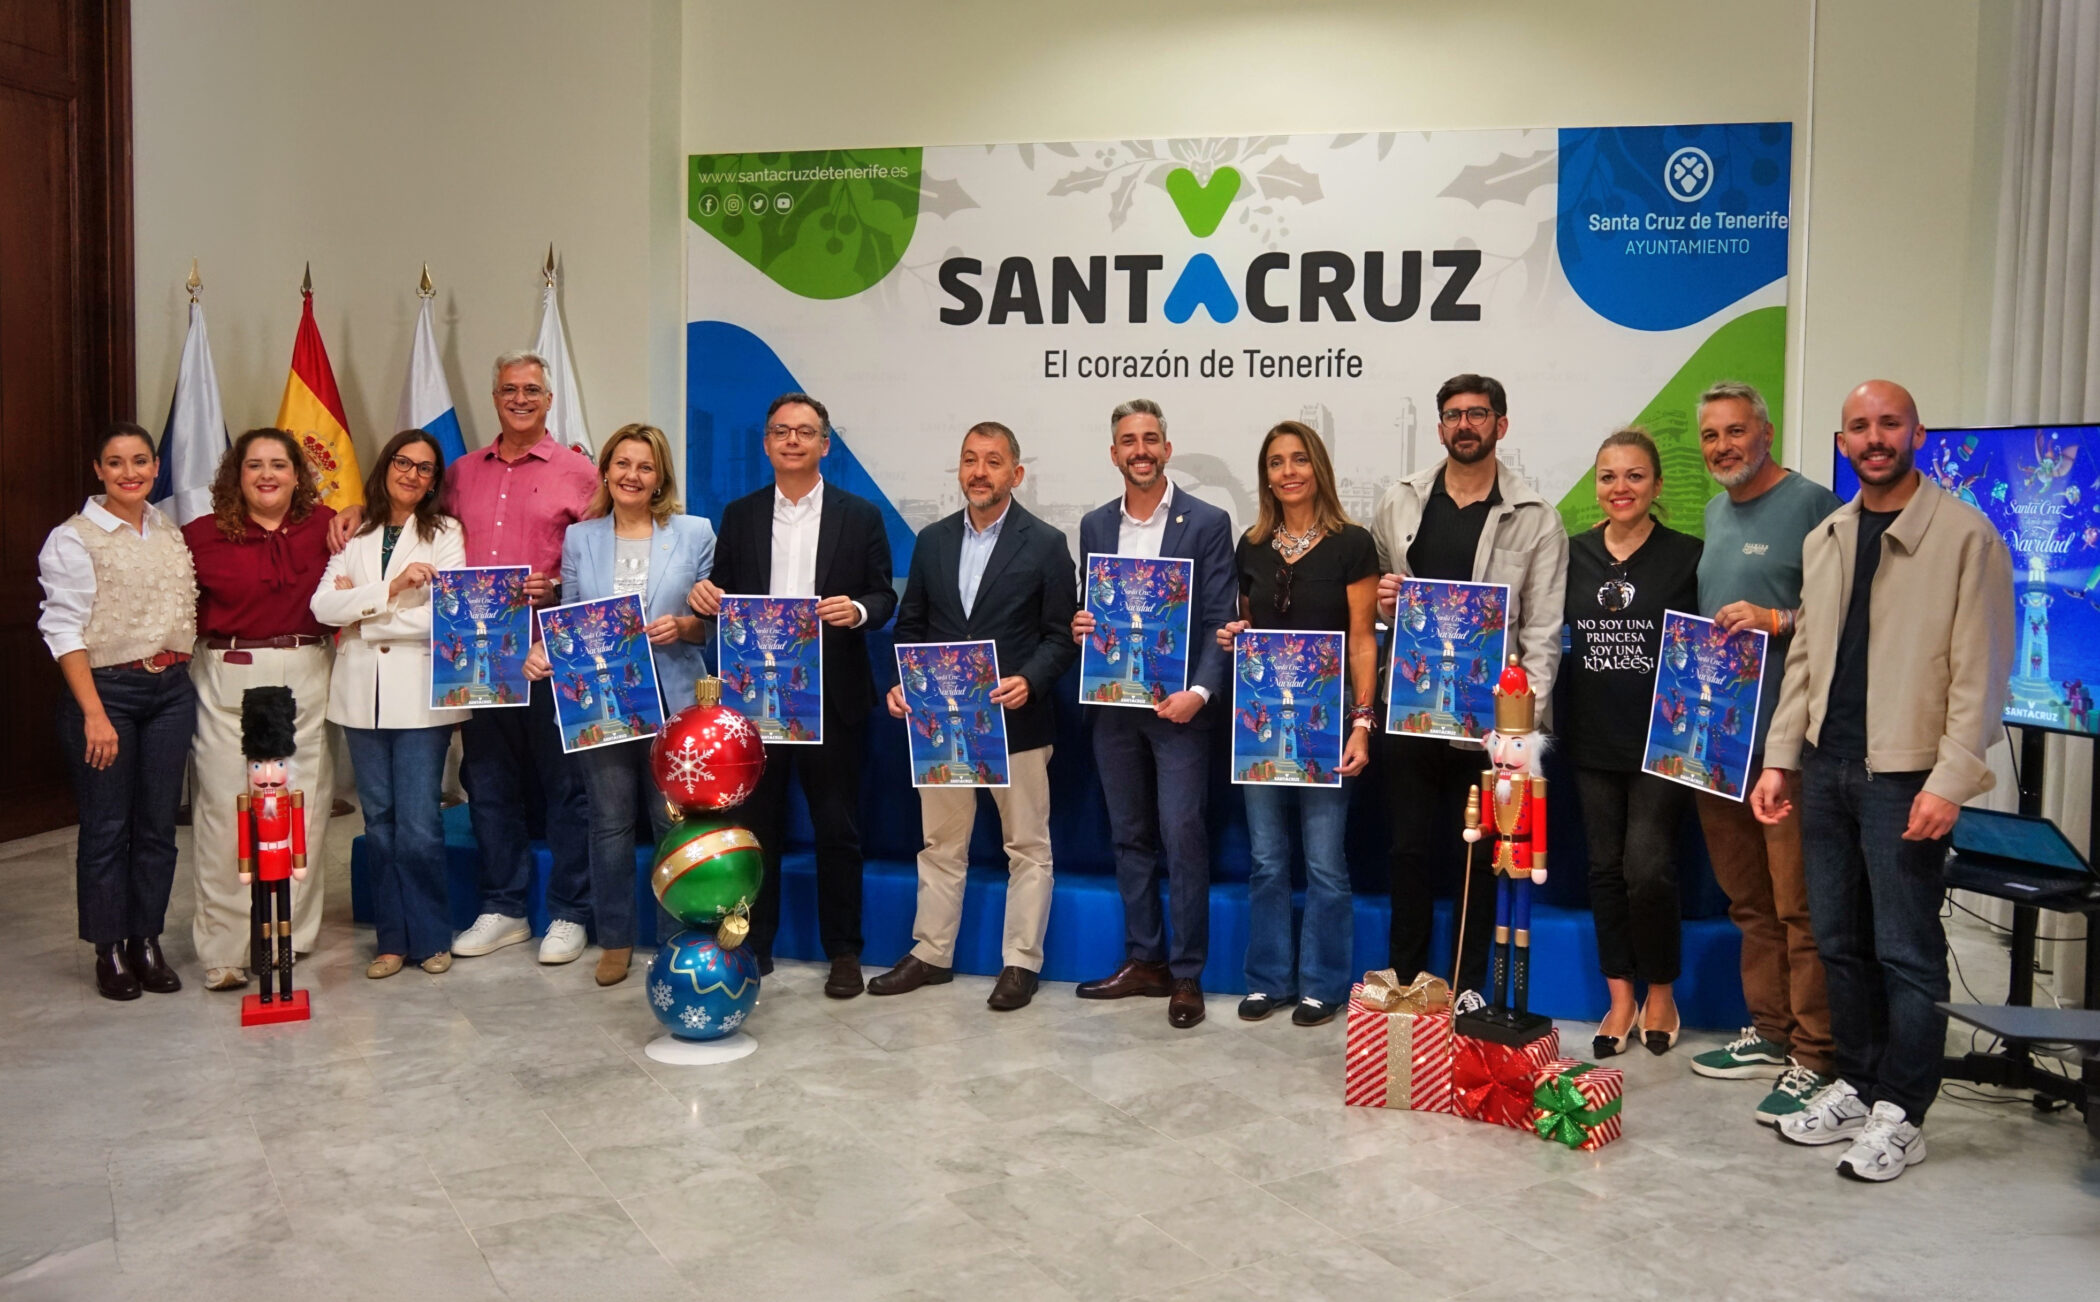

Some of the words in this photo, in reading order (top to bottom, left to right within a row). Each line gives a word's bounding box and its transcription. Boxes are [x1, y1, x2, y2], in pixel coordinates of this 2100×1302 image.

[699, 164, 908, 184] www.santacruzdetenerife.es
[1588, 213, 1640, 232] Santa
[1644, 212, 1686, 231] Cruz
[1690, 211, 1711, 230] de
[1715, 210, 1789, 231] Tenerife
[1625, 238, 1750, 256] AYUNTAMIENTO
[1044, 350, 1068, 378] El
[1076, 347, 1190, 379] corazón
[1199, 349, 1234, 378] de
[1242, 347, 1364, 379] Tenerife
[2004, 500, 2038, 516] Santa
[2040, 500, 2074, 518] Cruz
[2003, 527, 2076, 553] Navidad
[1577, 619, 1596, 630] NO
[1600, 619, 1623, 630] SOY
[1626, 619, 1655, 630] UNA
[1586, 632, 1646, 643] PRINCESA
[1590, 645, 1613, 656] SOY
[1615, 645, 1644, 656] UNA
[2004, 705, 2059, 722] SANTACRUZ
